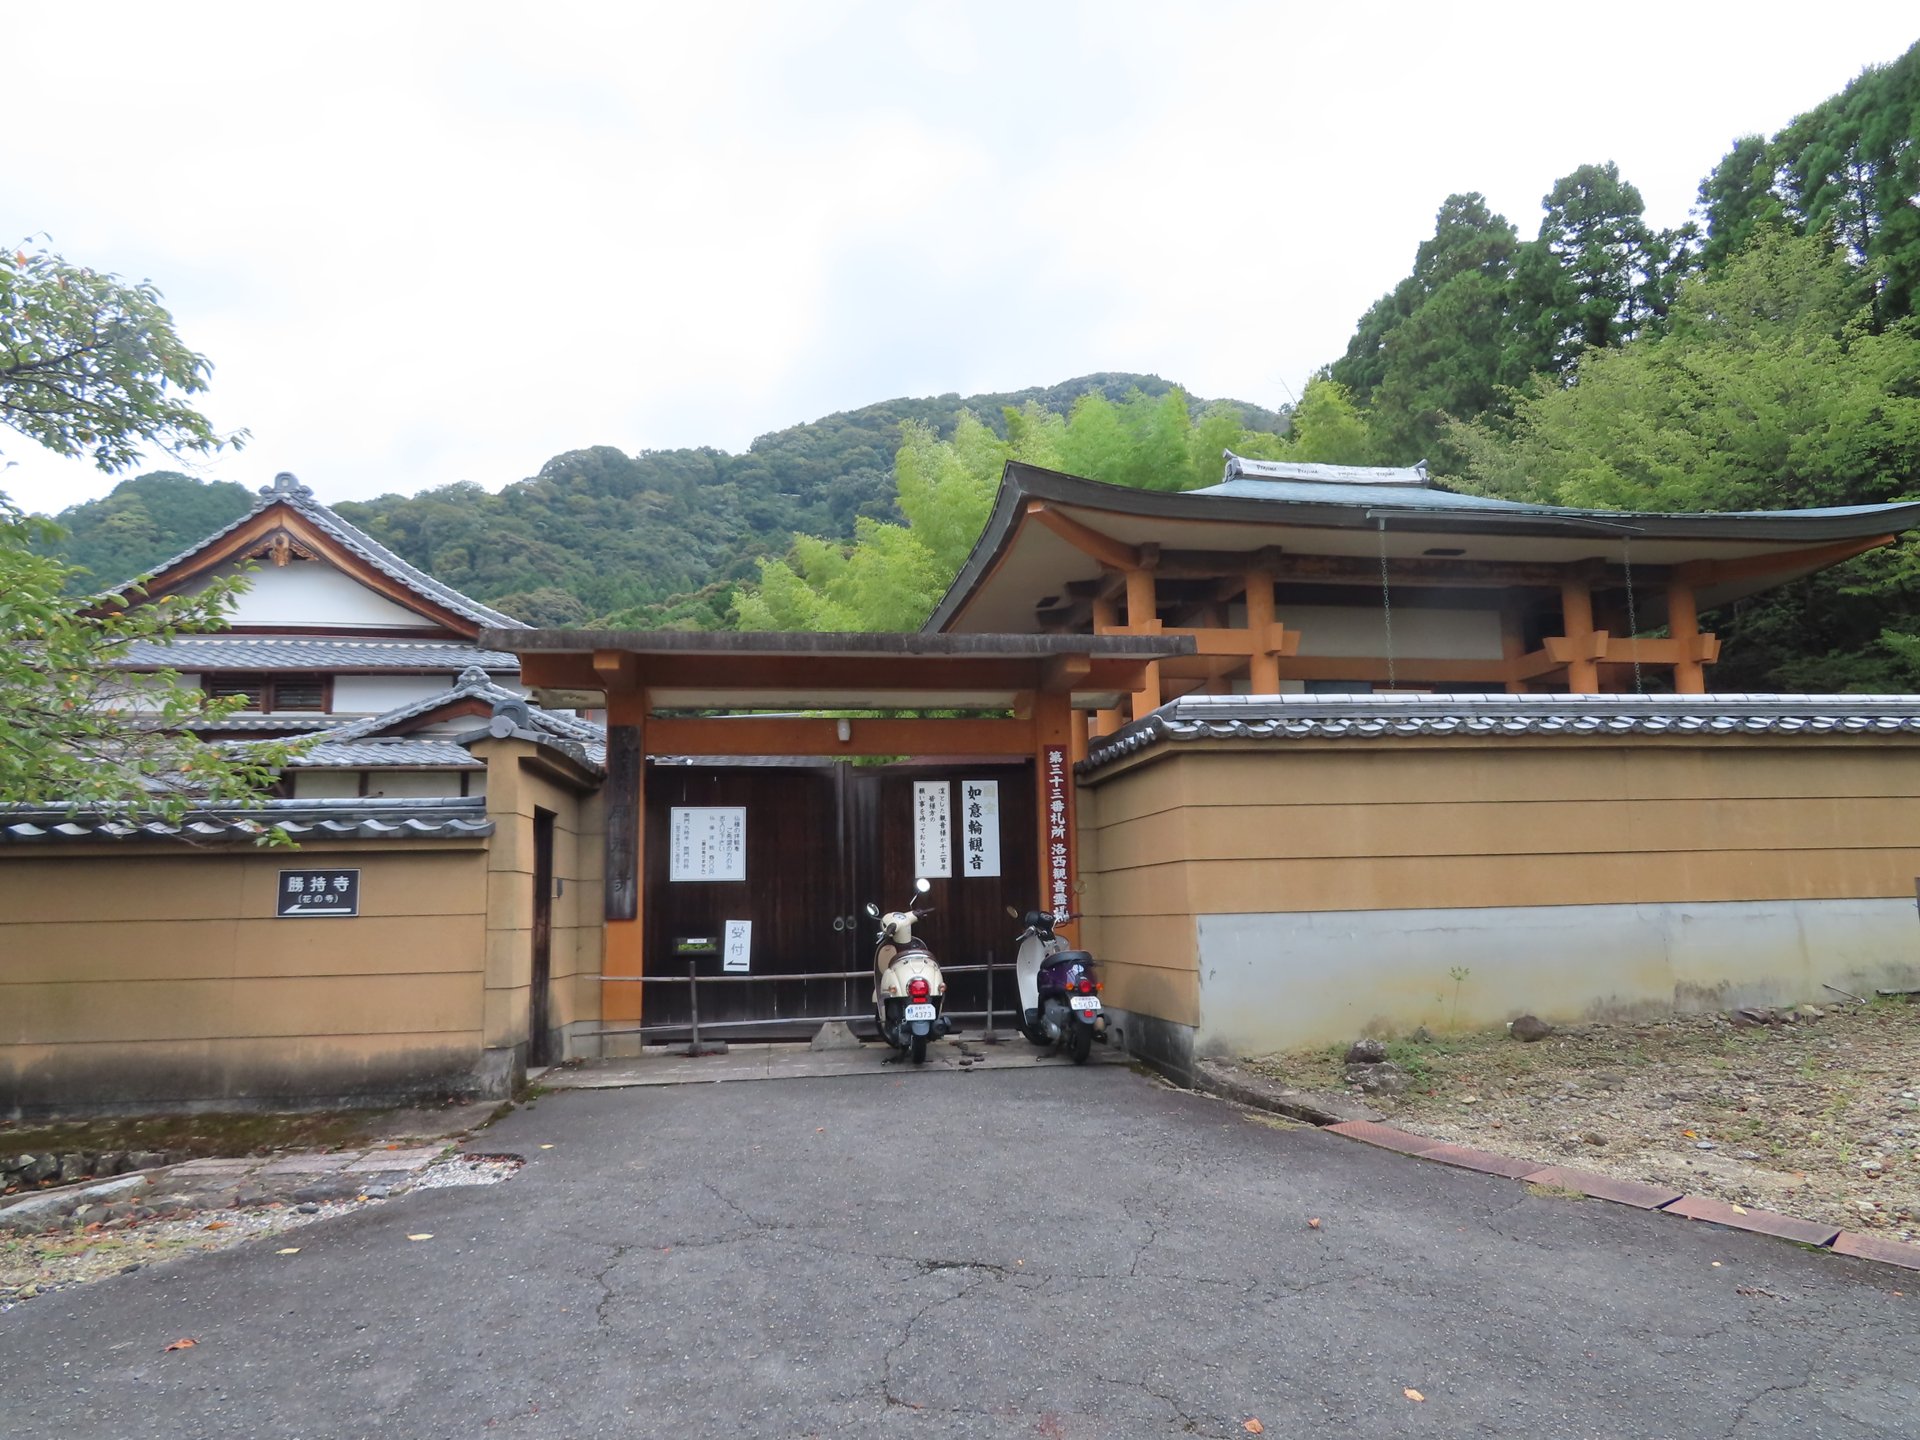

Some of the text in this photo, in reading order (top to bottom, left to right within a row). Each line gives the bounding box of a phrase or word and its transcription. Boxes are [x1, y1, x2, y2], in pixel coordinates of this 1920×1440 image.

[1048, 750, 1066, 839] 第三十三番札所
[967, 785, 984, 870] 如意輪観音
[287, 876, 350, 893] 勝持寺
[731, 926, 745, 956] 受付
